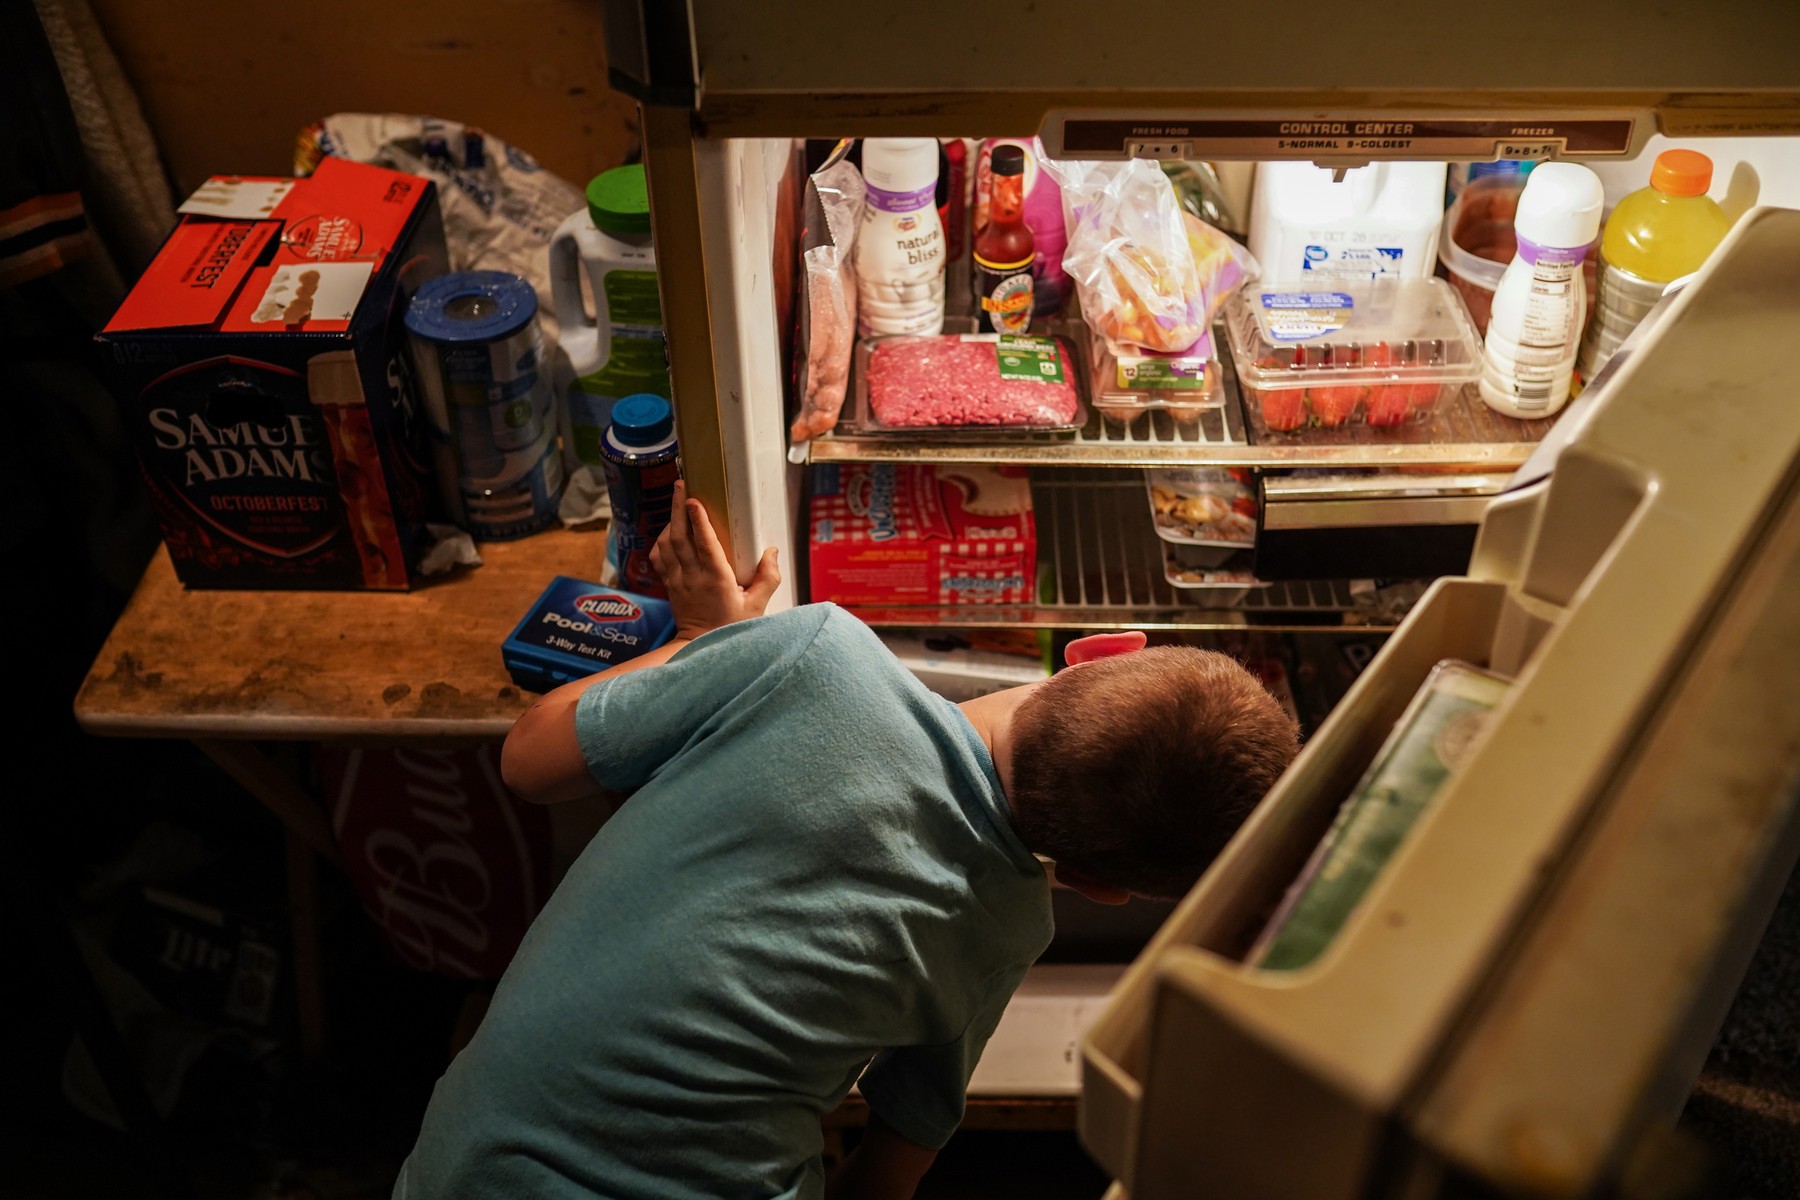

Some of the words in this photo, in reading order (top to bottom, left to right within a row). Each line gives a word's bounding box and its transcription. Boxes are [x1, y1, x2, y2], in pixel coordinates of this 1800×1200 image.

[1132, 127, 1162, 135] FRESH
[1165, 127, 1189, 135] FOOD
[1280, 122, 1349, 135] CONTROL
[1355, 122, 1414, 135] CENTER
[1279, 140, 1338, 148] 5-NORMAL
[1347, 140, 1411, 148] 9-COLDEST
[896, 224, 940, 250] natural
[907, 249, 940, 265] bliss
[1125, 367, 1135, 377] 12
[148, 407, 320, 450] SAMUE
[185, 448, 335, 487] ADAMS
[209, 493, 329, 513] OCTOBERFEST
[579, 599, 636, 617] CLOROX
[545, 634, 576, 651] 3-Way
[577, 643, 597, 656] Test
[597, 647, 612, 660] Kit
